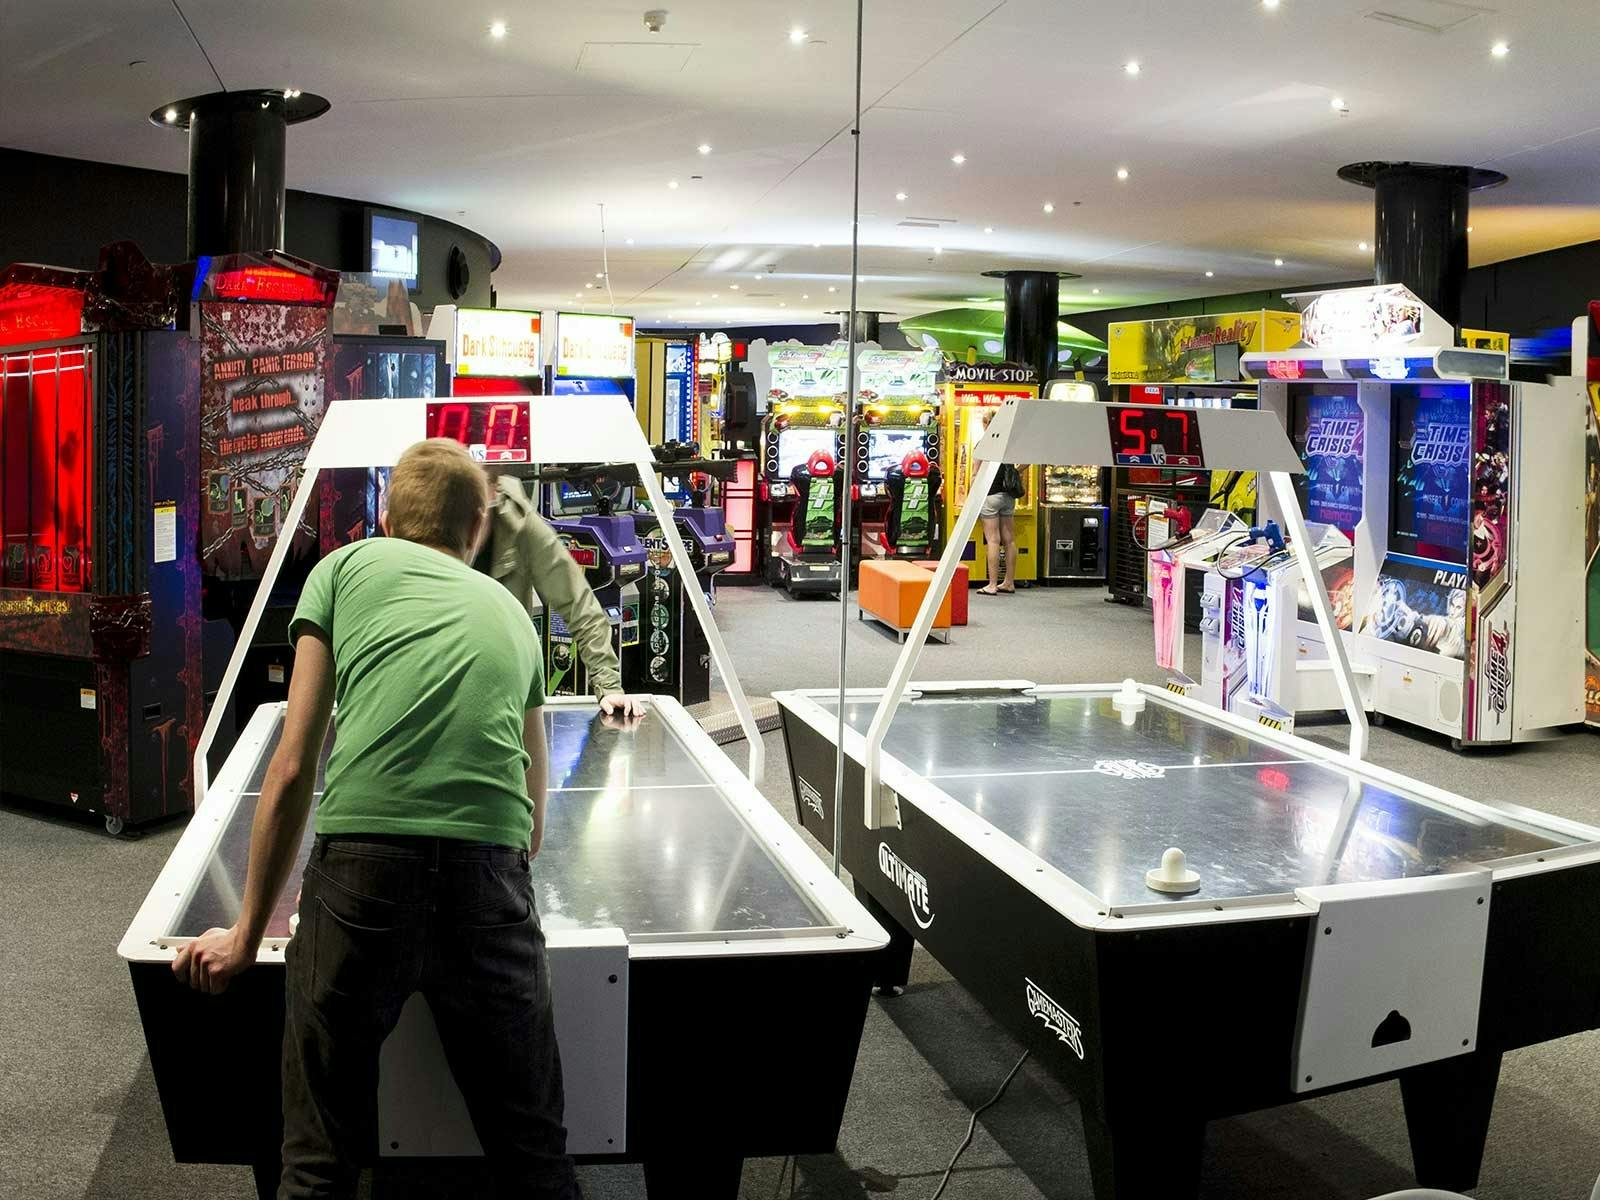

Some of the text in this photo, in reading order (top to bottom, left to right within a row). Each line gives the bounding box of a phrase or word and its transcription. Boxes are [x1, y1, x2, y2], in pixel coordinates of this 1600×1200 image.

[463, 334, 486, 357] Dark
[955, 367, 1035, 382] MOVIE STOP
[485, 404, 518, 450] 0
[1120, 409, 1145, 455] 5
[1166, 412, 1188, 454] 7
[1321, 419, 1358, 437] TIME
[1428, 423, 1468, 443] TIME
[471, 450, 485, 460] VS
[1306, 436, 1352, 456] CRISIS
[1412, 443, 1465, 463] CRISIS
[1152, 453, 1166, 465] VS
[1489, 651, 1498, 692] TIME
[1496, 654, 1506, 711] CRISIS
[879, 841, 935, 930] ULTIMATE
